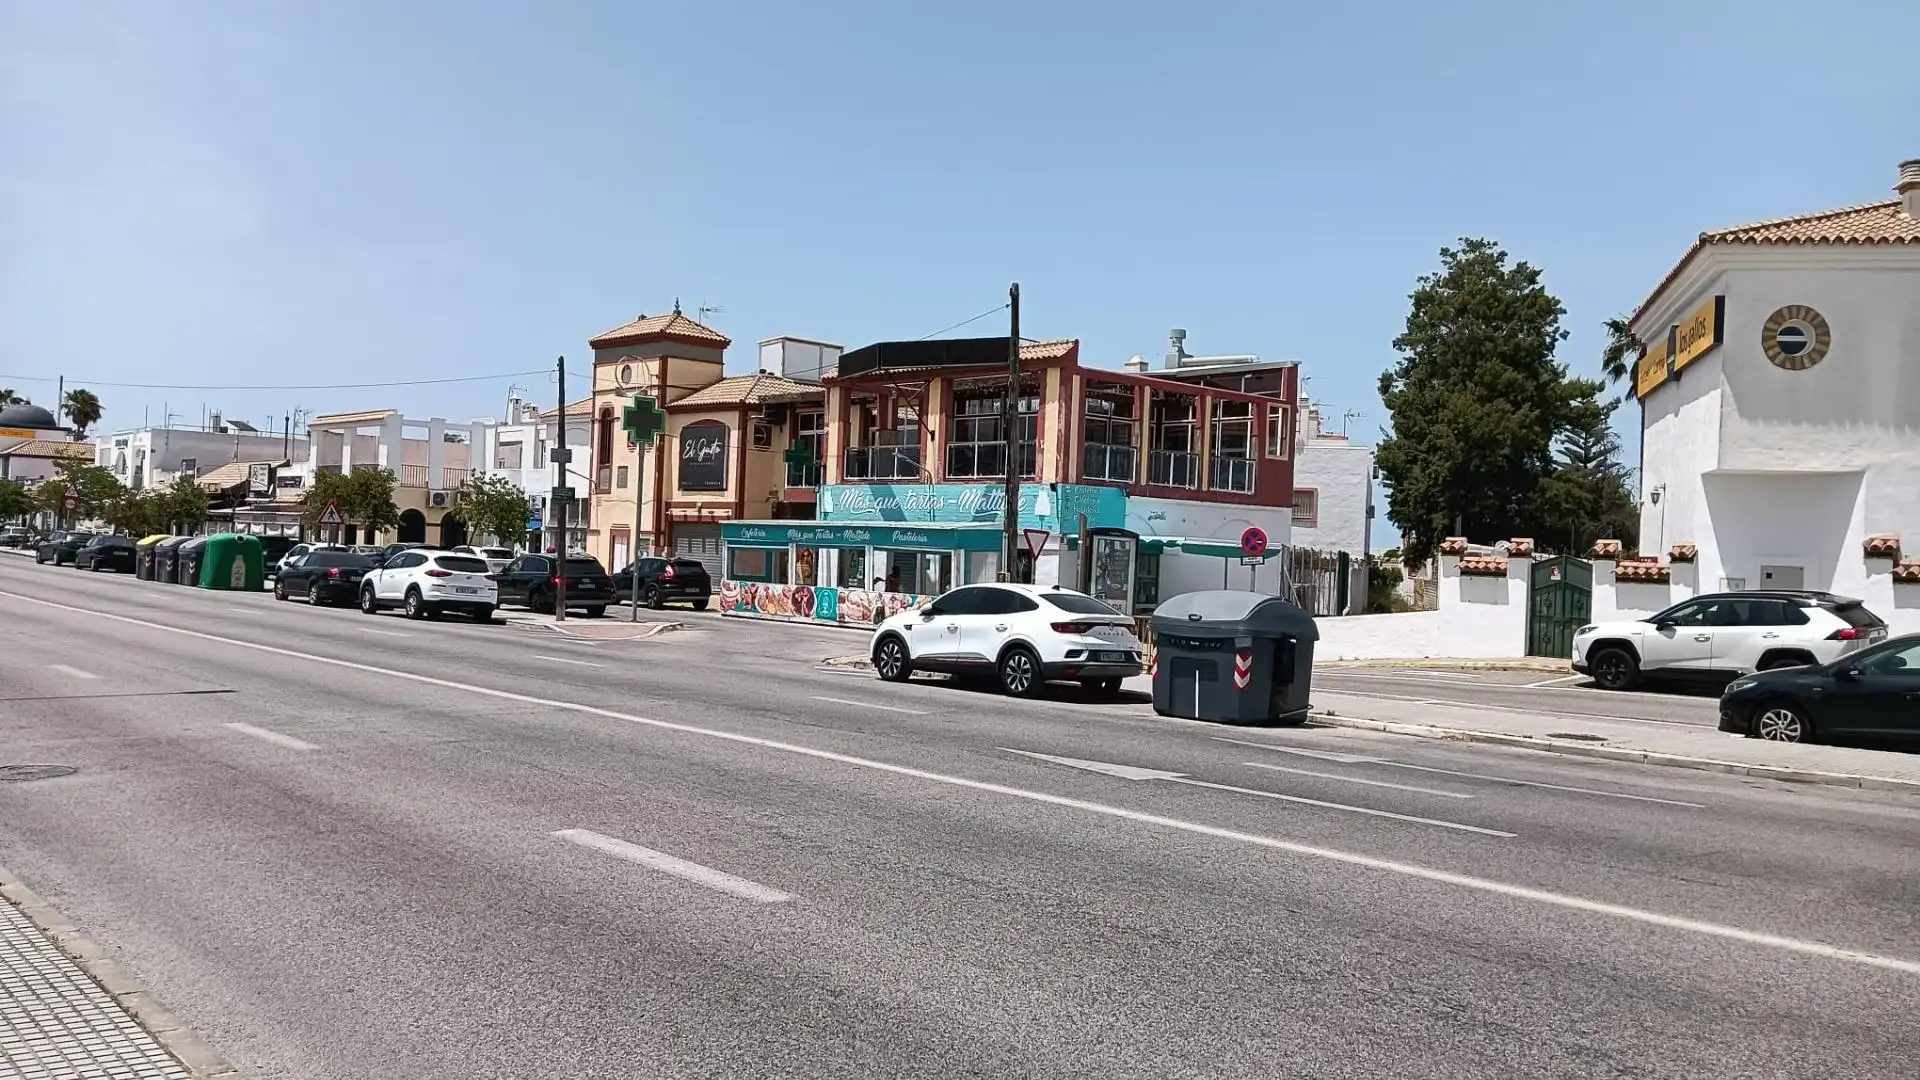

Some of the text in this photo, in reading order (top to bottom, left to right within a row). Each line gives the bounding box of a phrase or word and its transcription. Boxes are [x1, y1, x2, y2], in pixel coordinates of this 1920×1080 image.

[682, 437, 723, 462] El Gusto
[839, 488, 875, 514] Más
[874, 495, 901, 517] que
[903, 489, 945, 512] tartas
